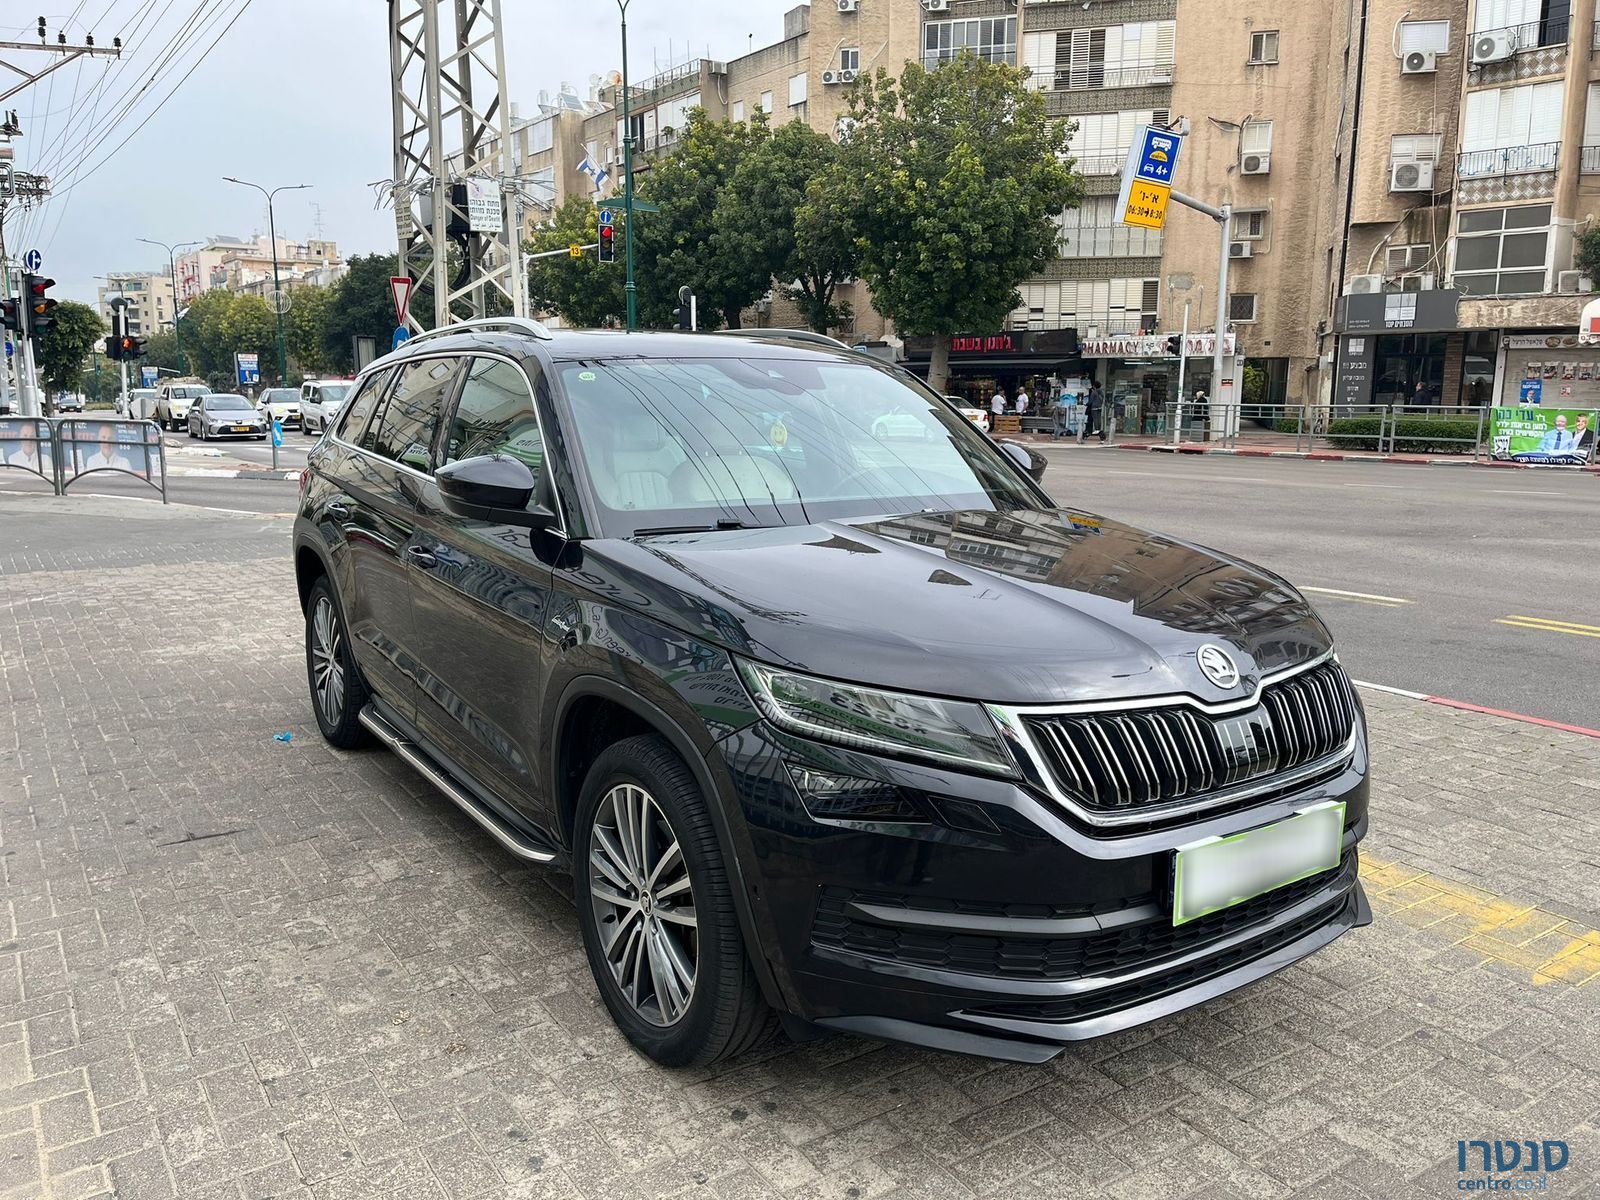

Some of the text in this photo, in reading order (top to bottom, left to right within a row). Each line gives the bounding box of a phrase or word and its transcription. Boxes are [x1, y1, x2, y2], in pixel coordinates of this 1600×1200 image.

[1155, 165, 1168, 175] 4+
[571, 247, 580, 255] 13
[952, 334, 1012, 353] ג'חנון בשבת
[1081, 340, 1139, 354] PHARMACY
[1515, 410, 1534, 421] עדי
